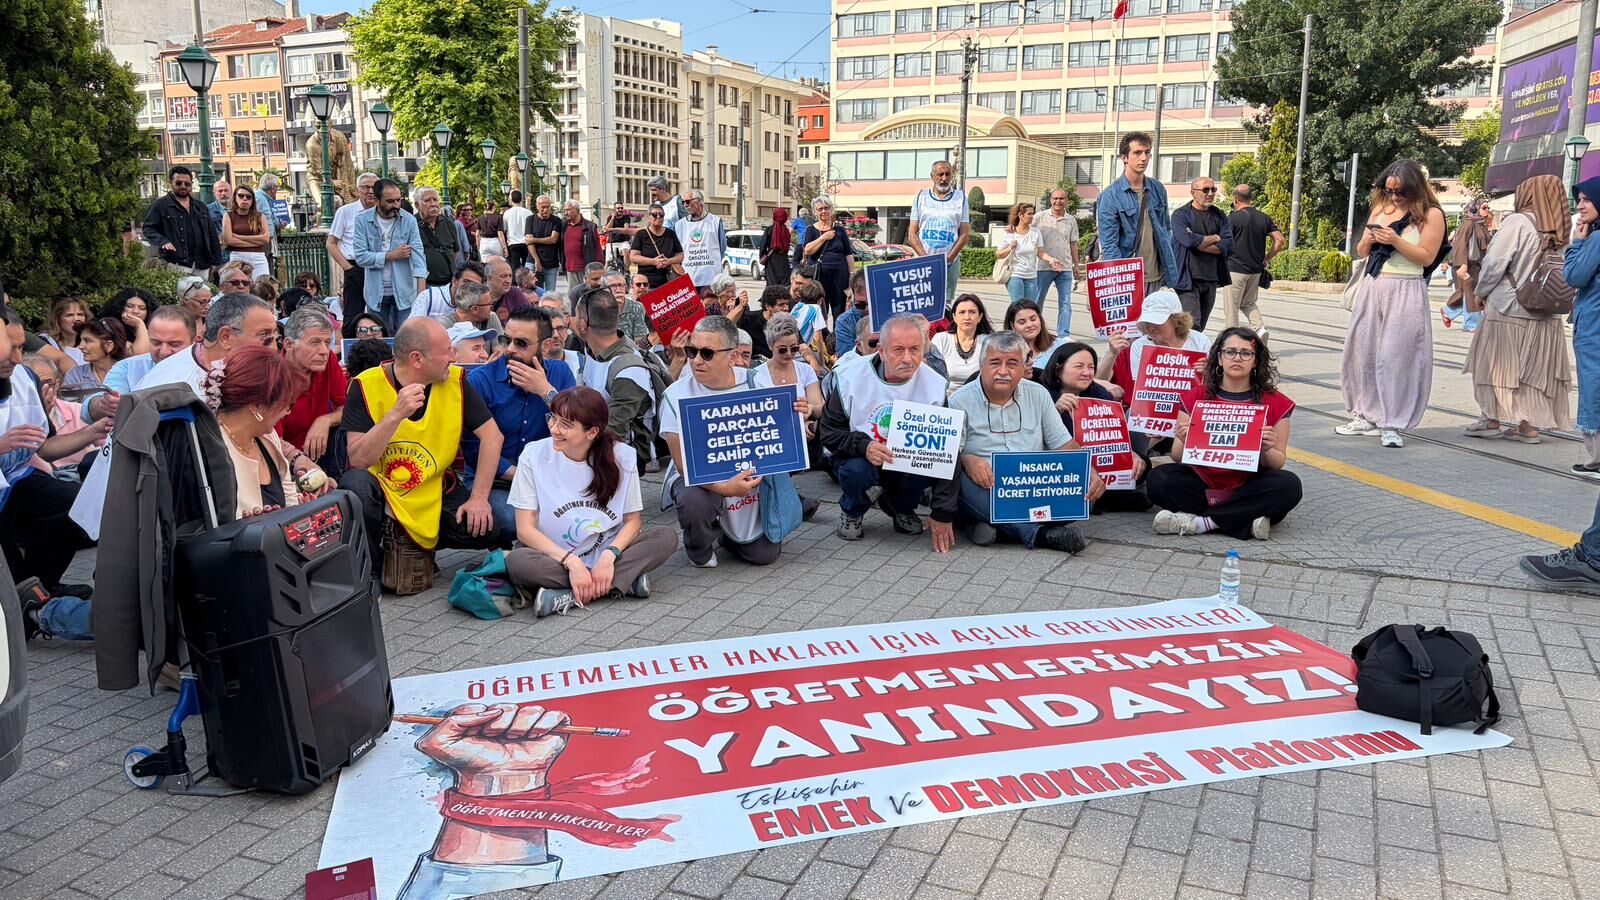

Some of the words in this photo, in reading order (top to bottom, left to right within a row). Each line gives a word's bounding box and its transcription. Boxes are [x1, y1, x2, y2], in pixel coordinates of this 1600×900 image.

[922, 229, 955, 242] KESK
[889, 266, 932, 284] YUSUF
[1088, 262, 1141, 279] ÖĞRETMENLERE
[1094, 273, 1136, 288] EMEKÇİLERE
[893, 280, 932, 298] TEKİN
[1095, 283, 1136, 298] EMEKLİLERE
[651, 299, 667, 312] Özel
[666, 287, 690, 303] Okullar
[891, 295, 935, 314] İSTİFA!
[1101, 294, 1131, 309] HEMEN
[1107, 308, 1126, 321] ZAM
[1156, 352, 1190, 367] DÜŞÜK
[1145, 364, 1196, 378] ÜCRETLERE
[1144, 377, 1191, 391] MÜLAKATA
[700, 398, 779, 420] KARANLIĞI
[1088, 404, 1114, 417] DÜŞÜK
[1156, 403, 1172, 412] SON
[1202, 408, 1257, 416] EMEKÇİLERE
[707, 415, 776, 434] PARÇALA
[903, 409, 925, 423] Özel
[929, 414, 952, 425] Okul
[1081, 418, 1122, 430] ÜCRETLERE
[1201, 414, 1254, 423] EMEKLİLERE
[896, 421, 957, 436] Sömürüsüne
[1144, 419, 1173, 432] EHP
[1206, 423, 1246, 433] HEMEN
[707, 427, 780, 449] GELECEĞE
[904, 432, 947, 451] SON!
[1083, 429, 1123, 442] MÜLAKATA
[1211, 434, 1236, 445] ZAM
[707, 445, 751, 464] SAHİP
[754, 443, 784, 460] ÇIK!
[892, 447, 917, 455] Herkese
[917, 449, 946, 458] Güvenceli
[912, 455, 953, 464] yaşanabilecek
[1202, 451, 1235, 464] EHP
[735, 461, 756, 472] SOL
[911, 461, 934, 469] ücret!
[1019, 461, 1063, 473] İNSANCA
[1098, 456, 1112, 465] SON
[1001, 475, 1061, 486] YAŞANACAK
[1063, 473, 1080, 483] BİR
[997, 488, 1030, 498] ÜCRET
[1033, 486, 1082, 497] İSTİYORUZ
[553, 500, 584, 518] ÖĞRETMEN
[585, 500, 617, 521] SENDİKASI
[467, 655, 708, 700] ÖĞRETMENLER
[722, 637, 859, 667] HAKLARI
[868, 629, 943, 654] İÇİN
[950, 623, 1042, 646] AÇLIK
[1045, 607, 1252, 638] GREVİNDELER!
[647, 638, 1304, 722] ÖĞRETMENLERİMİZİN
[664, 666, 1359, 775] YANINDAYIZ!
[738, 777, 865, 811] Eskişehir
[748, 796, 887, 843] EMEK
[889, 795, 925, 816] Ve
[921, 752, 1188, 815] DEMOKRASİ
[1186, 730, 1425, 775] Platformu
[450, 801, 546, 821] ÖĞRETMENİN
[548, 813, 616, 833] HAKKINI
[616, 826, 651, 838] VER!
